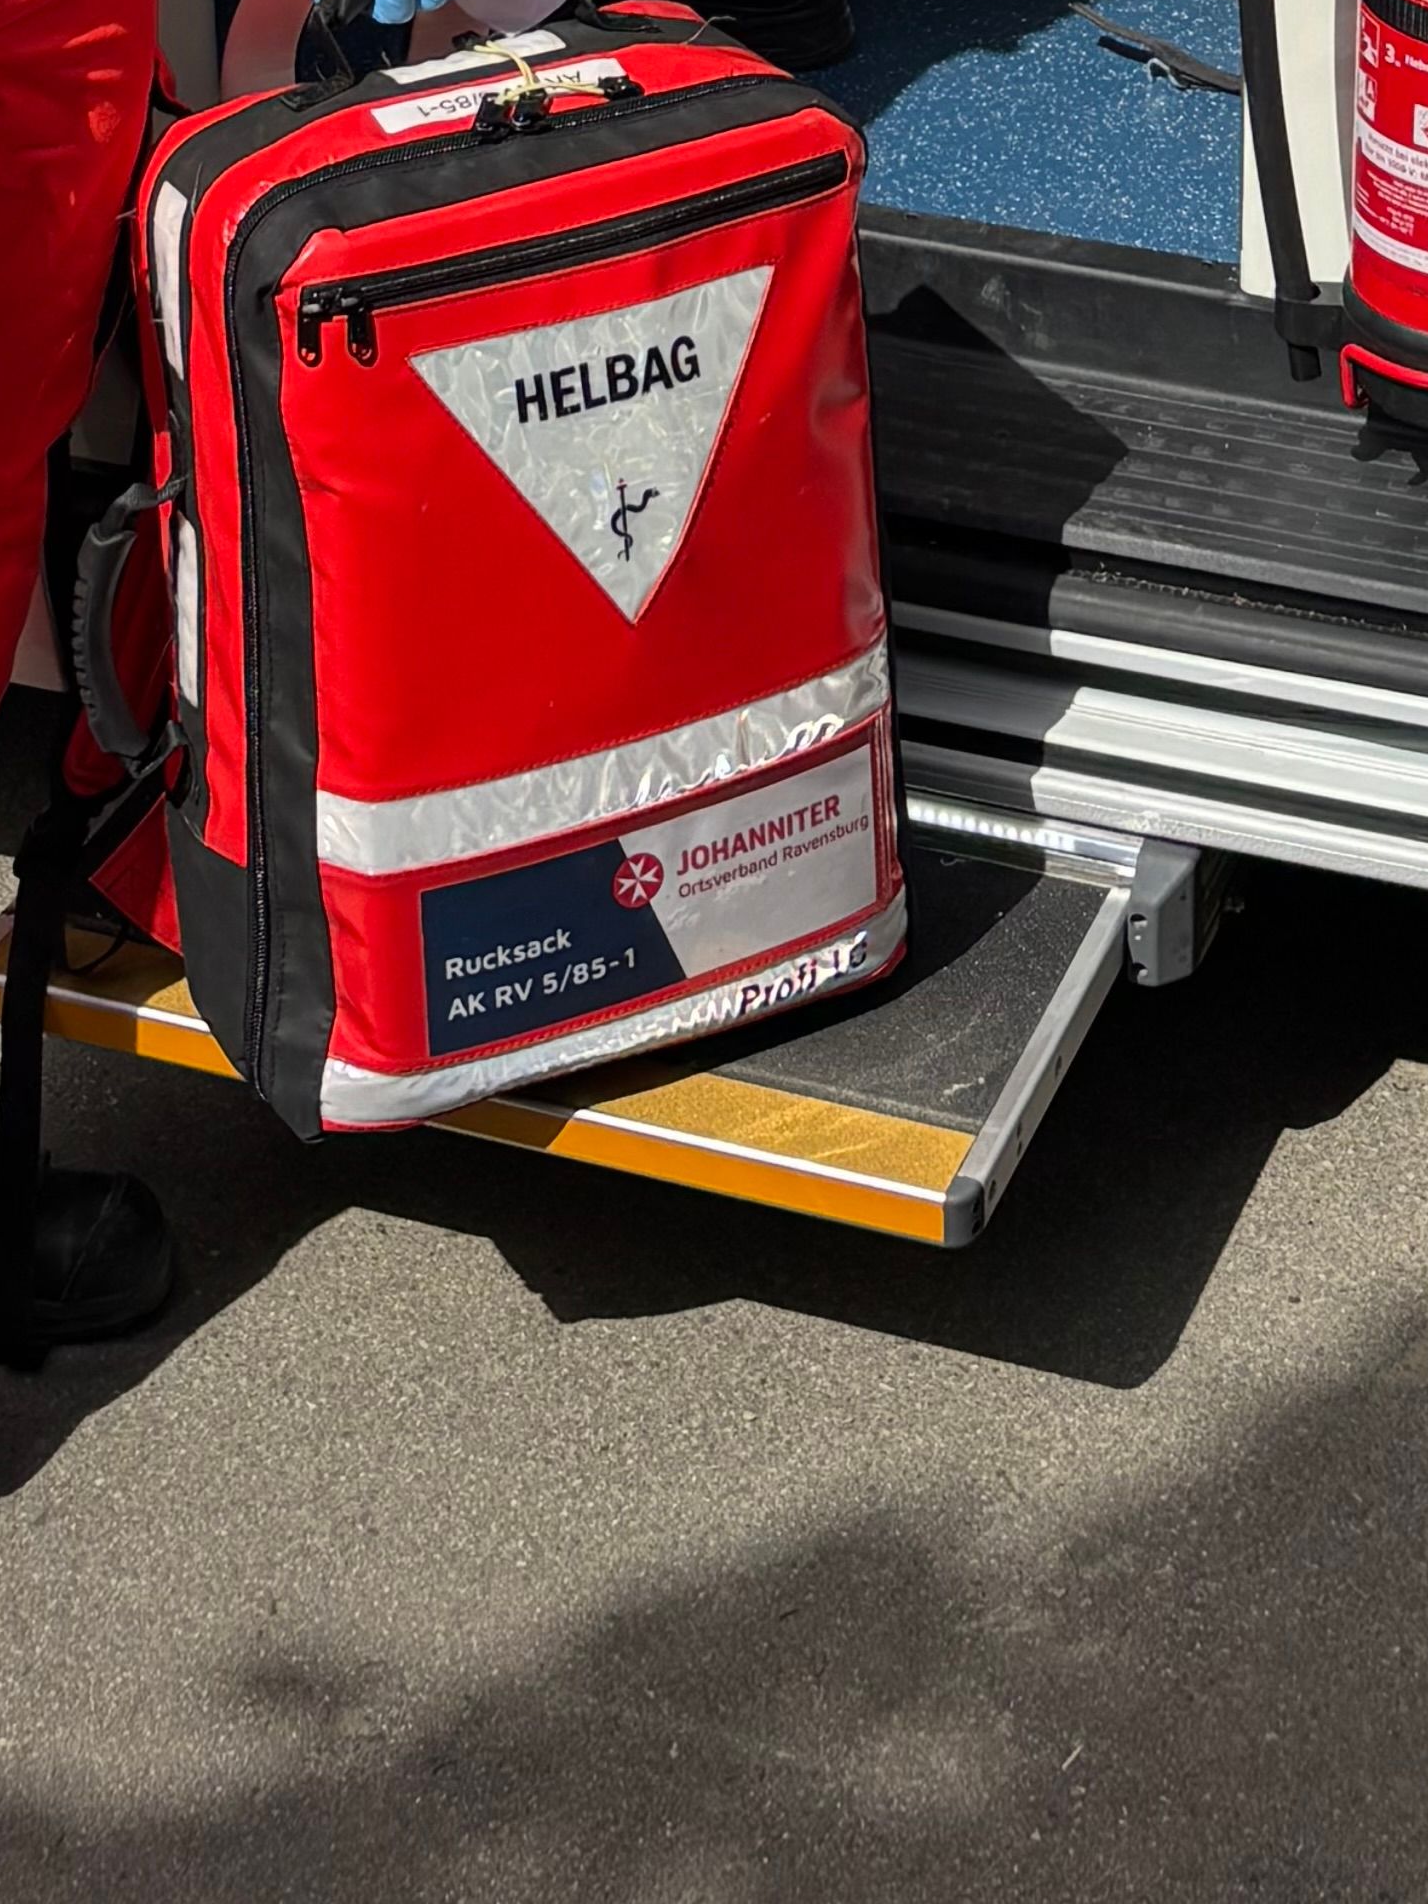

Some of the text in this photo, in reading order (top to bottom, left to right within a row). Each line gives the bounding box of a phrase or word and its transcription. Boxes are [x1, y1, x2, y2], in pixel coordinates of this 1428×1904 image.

[1384, 42, 1402, 68] 3.
[515, 335, 701, 424] HELBAG
[676, 794, 841, 877] JOHANNITER
[678, 814, 869, 898] Ortsverband Ravensburg
[445, 928, 572, 980] Rucksack
[448, 947, 635, 1022] AK RV 5/85-1
[739, 958, 818, 1016] Profi
